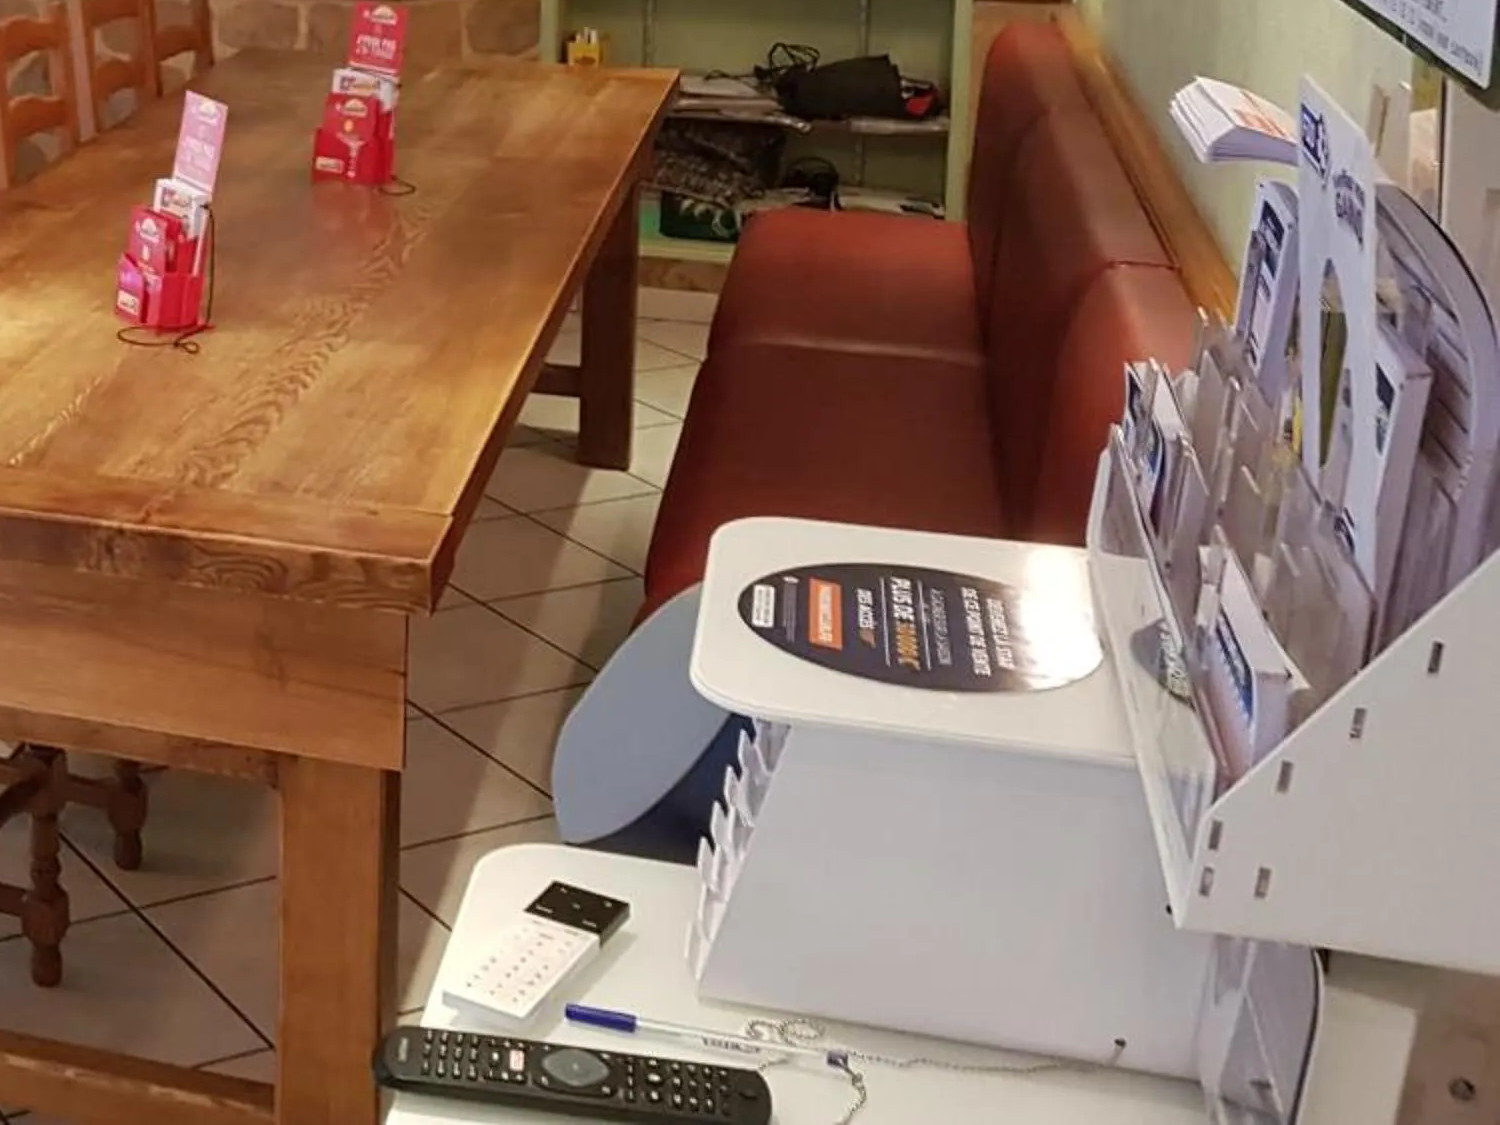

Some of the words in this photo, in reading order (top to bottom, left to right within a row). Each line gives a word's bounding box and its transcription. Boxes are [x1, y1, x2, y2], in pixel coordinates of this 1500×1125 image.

[856, 588, 874, 605] DES
[891, 576, 914, 605] PLUS
[893, 604, 915, 621] DE
[966, 612, 985, 636] POINT
